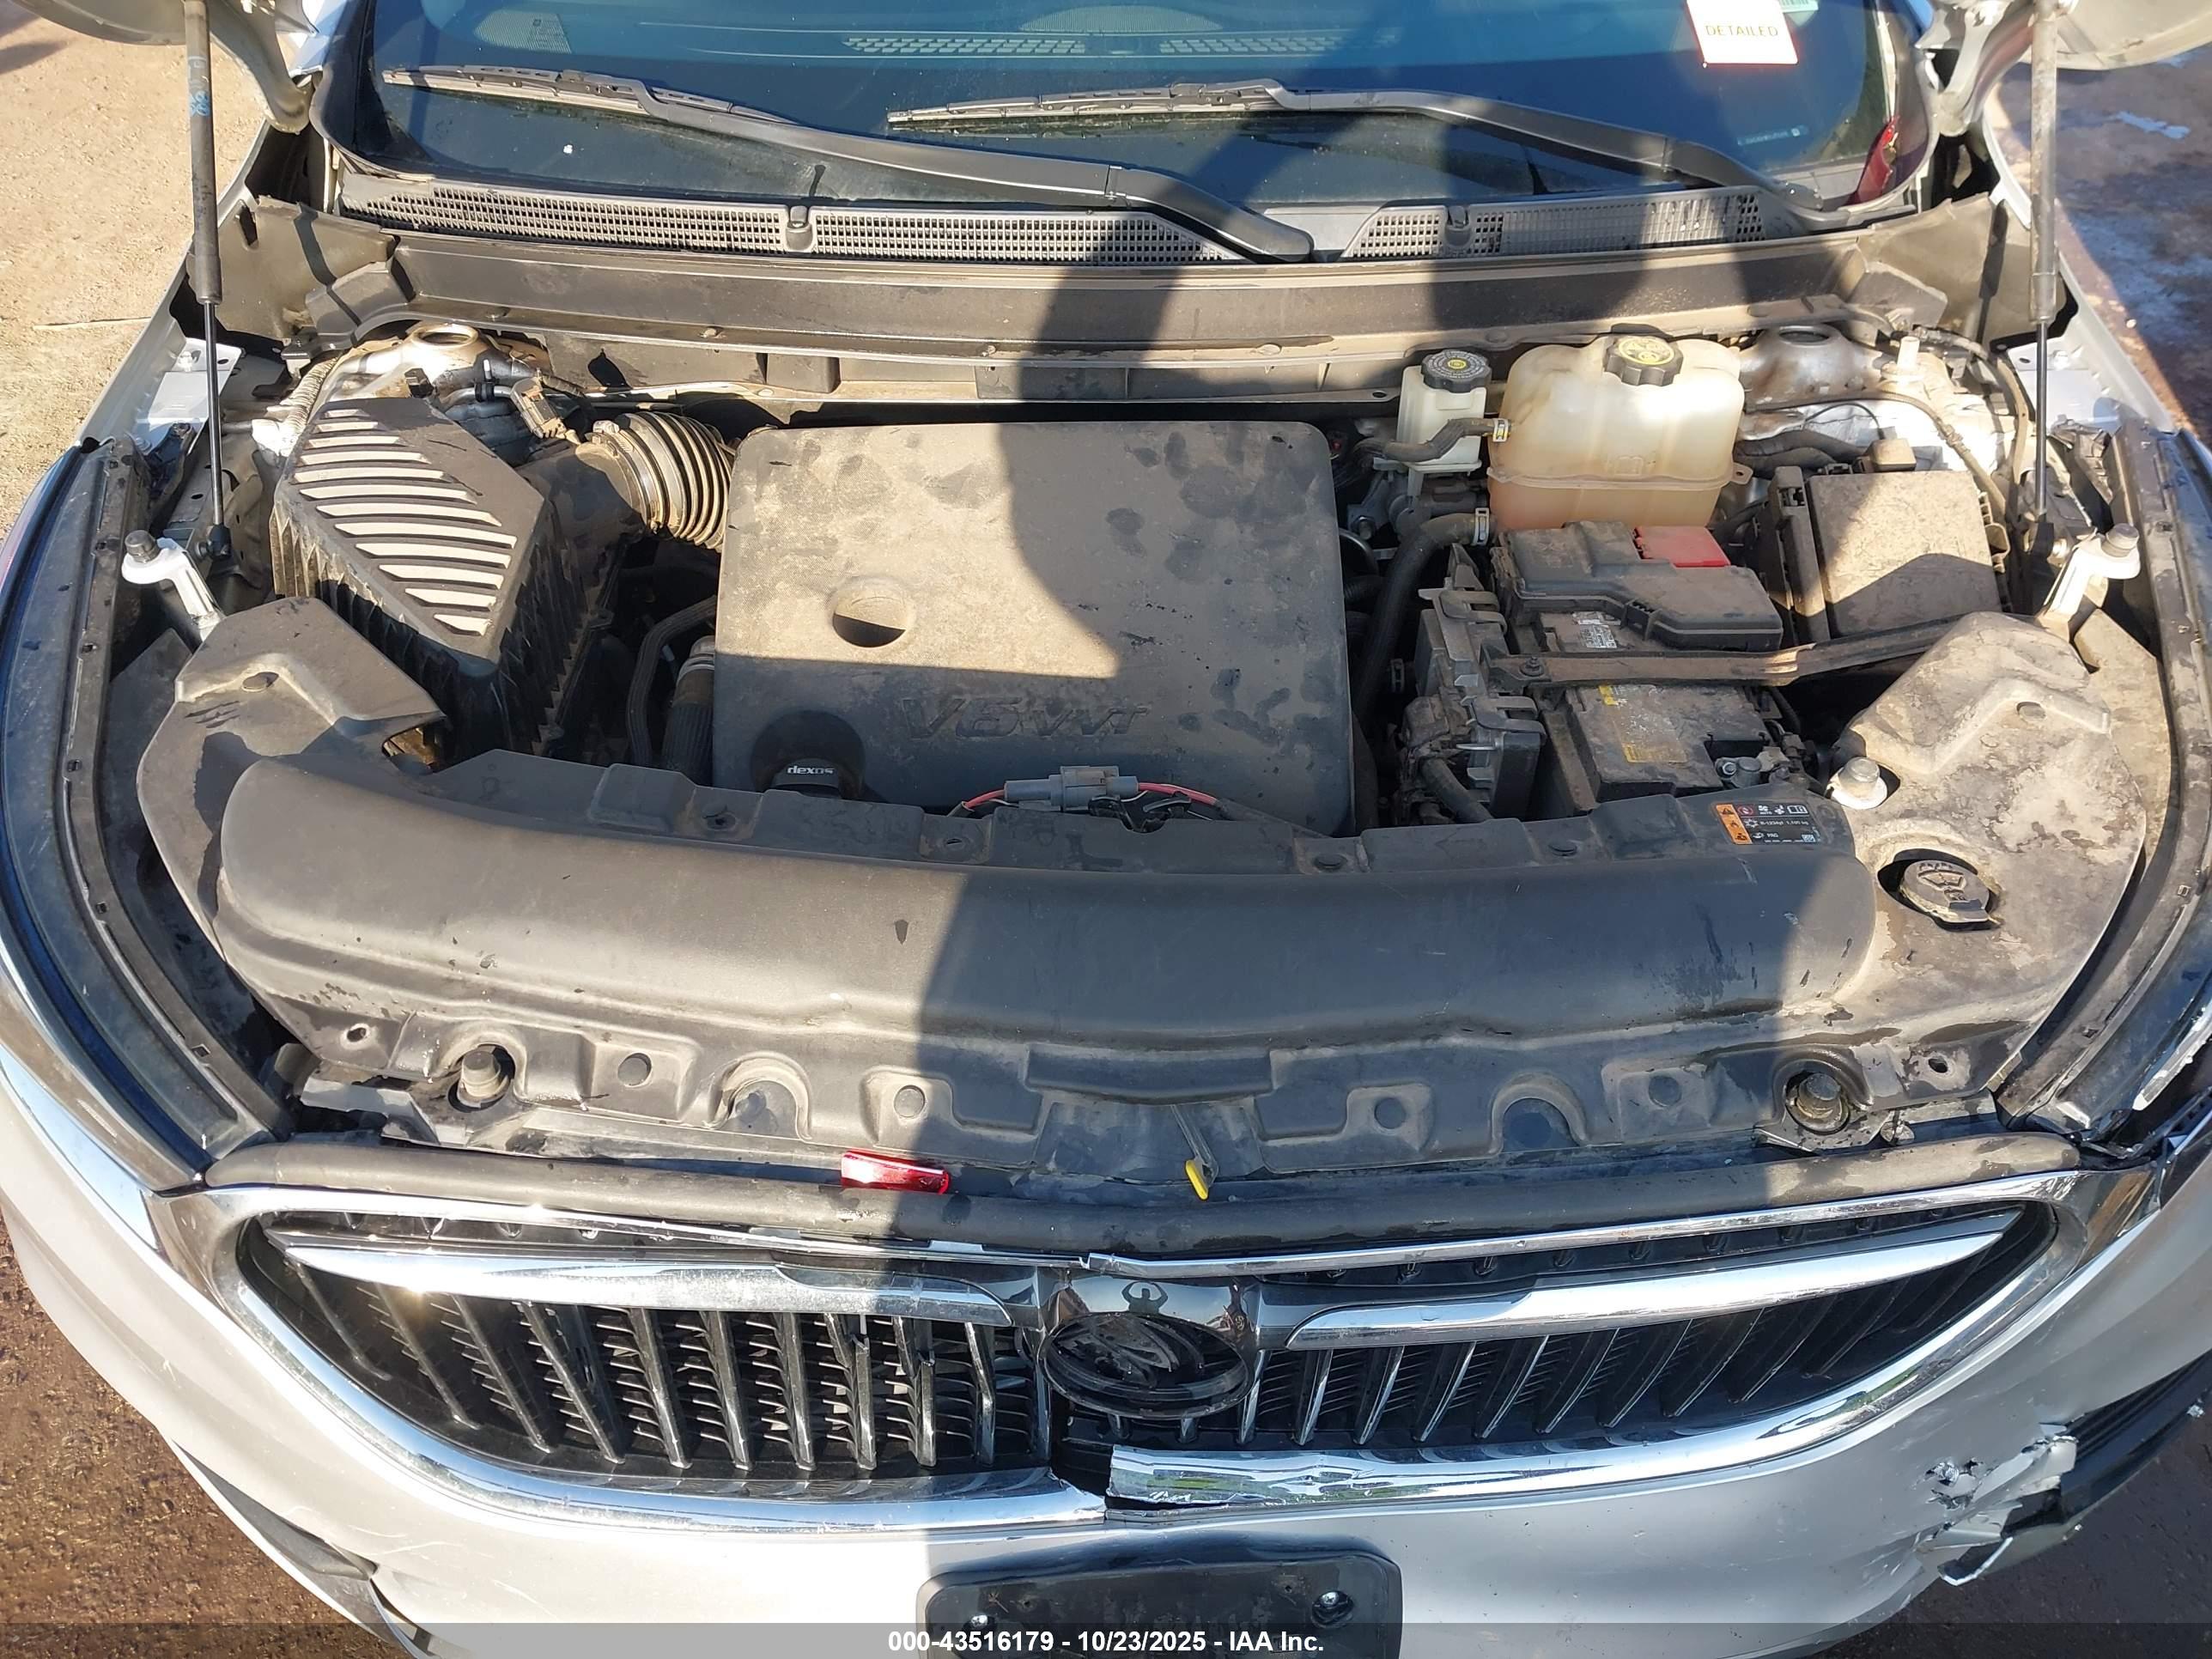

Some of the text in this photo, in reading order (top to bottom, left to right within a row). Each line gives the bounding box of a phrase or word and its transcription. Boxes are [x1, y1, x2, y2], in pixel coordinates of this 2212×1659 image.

[1705, 25, 1778, 37] DETAILED
[901, 696, 1023, 739] V6
[787, 765, 836, 775] dexos
